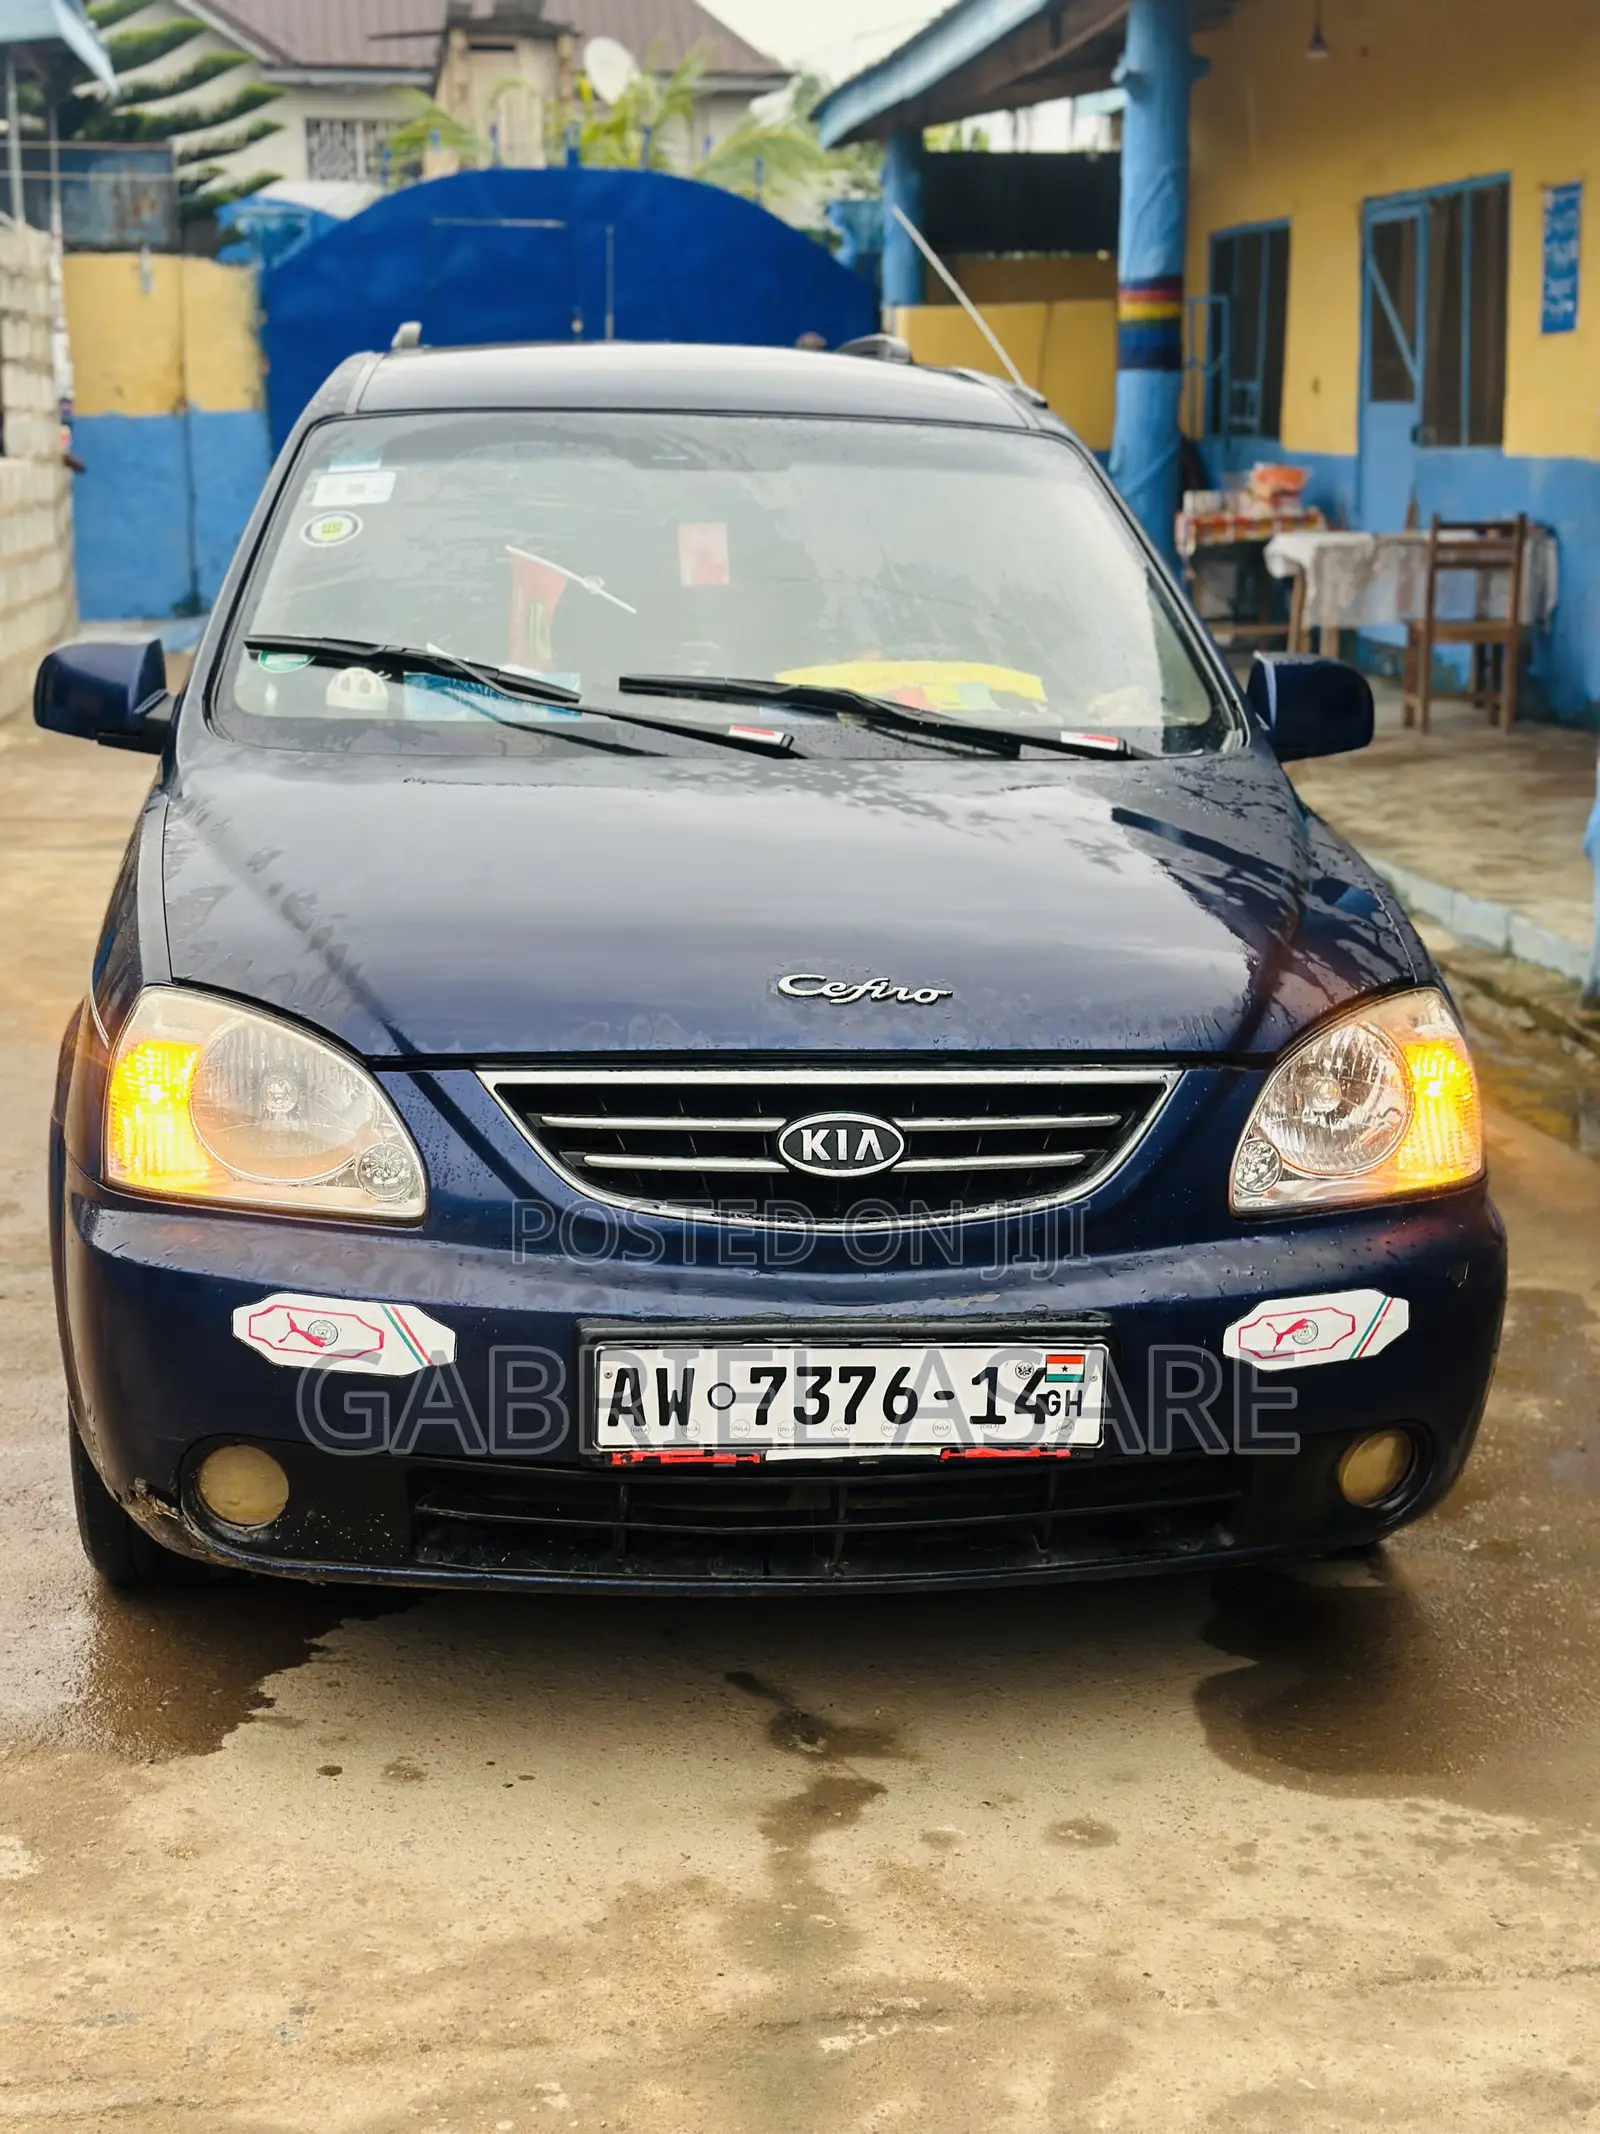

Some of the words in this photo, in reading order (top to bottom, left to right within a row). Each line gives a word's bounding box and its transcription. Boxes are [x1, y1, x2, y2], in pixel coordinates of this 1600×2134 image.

[778, 974, 953, 1004] Cefiro
[801, 1128, 885, 1161] KIA
[608, 1368, 695, 1427] AW
[1048, 1390, 1082, 1417] GH
